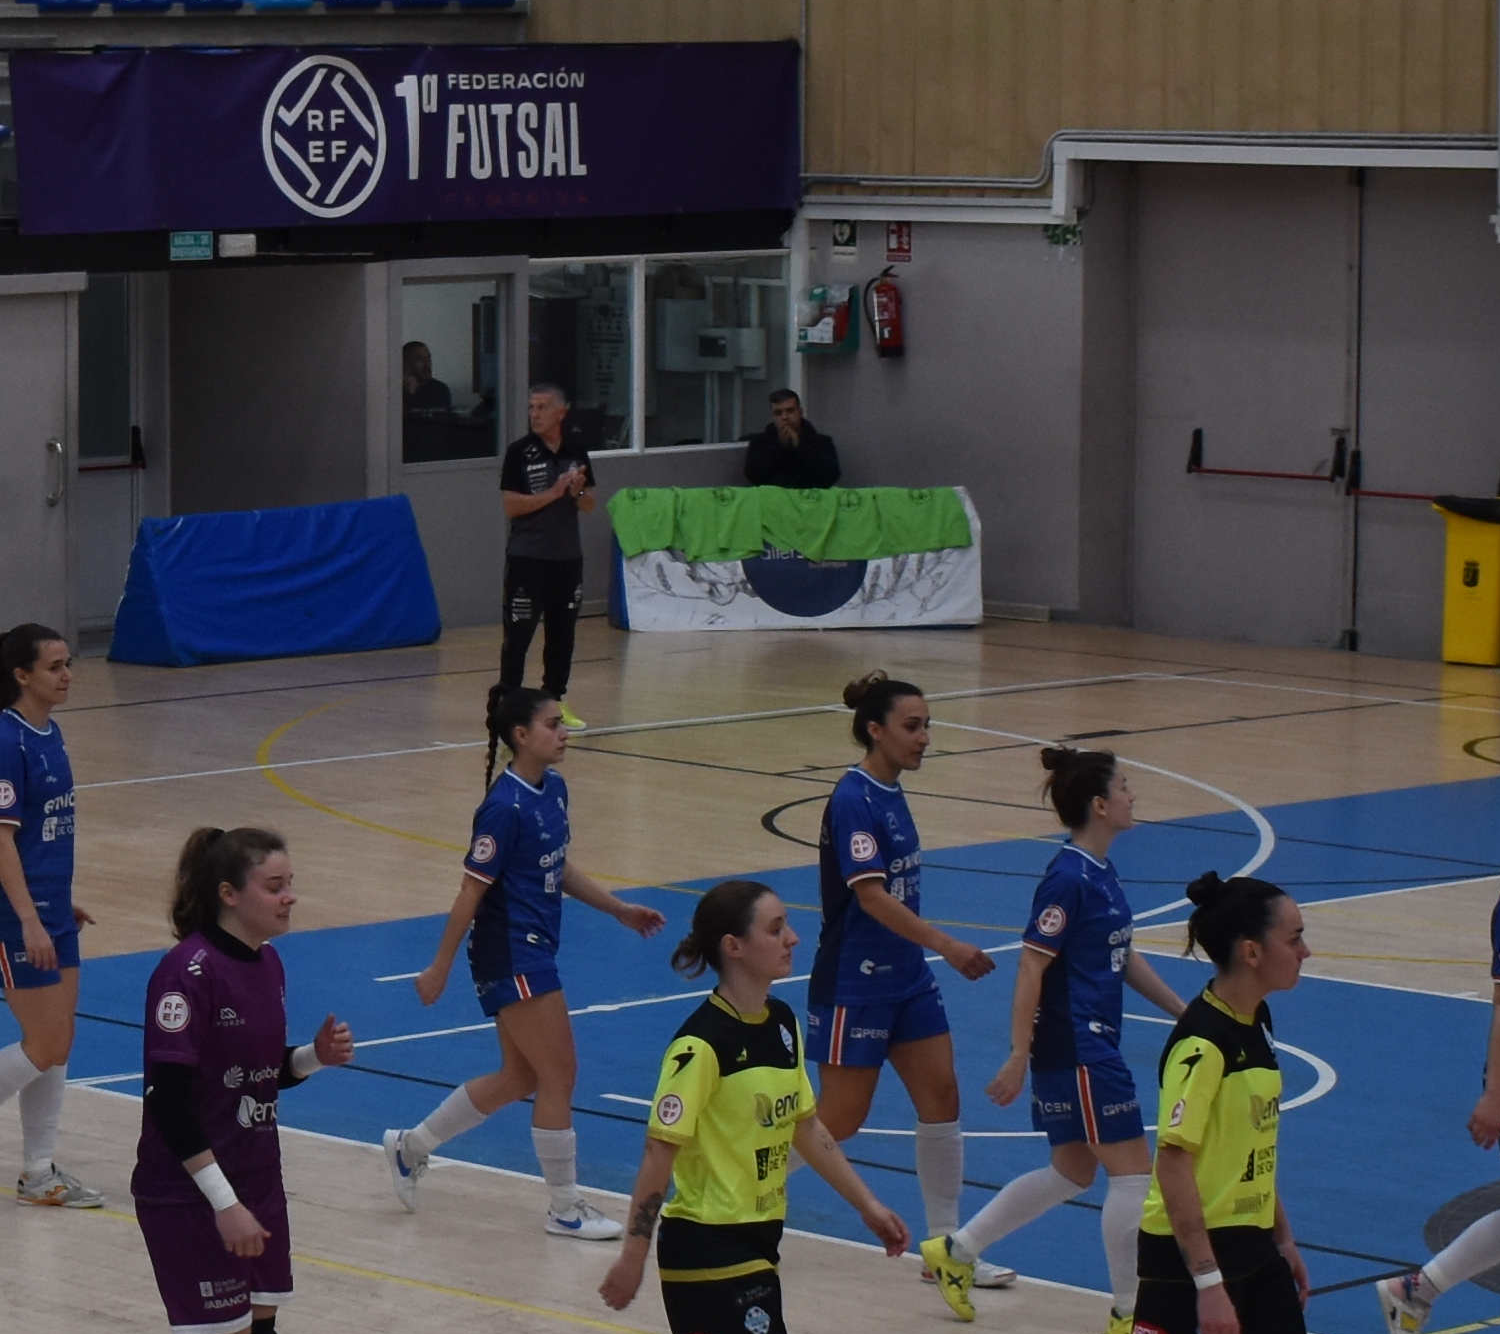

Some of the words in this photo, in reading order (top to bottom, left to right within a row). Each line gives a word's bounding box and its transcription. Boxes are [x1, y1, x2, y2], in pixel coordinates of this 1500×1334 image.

[447, 67, 585, 90] FEDERACIÓN
[446, 101, 588, 180] FUTSAL
[446, 192, 588, 209] FEMENINA
[163, 1002, 184, 1011] RF
[163, 1013, 182, 1022] EF
[204, 1294, 248, 1310] ABANCA
